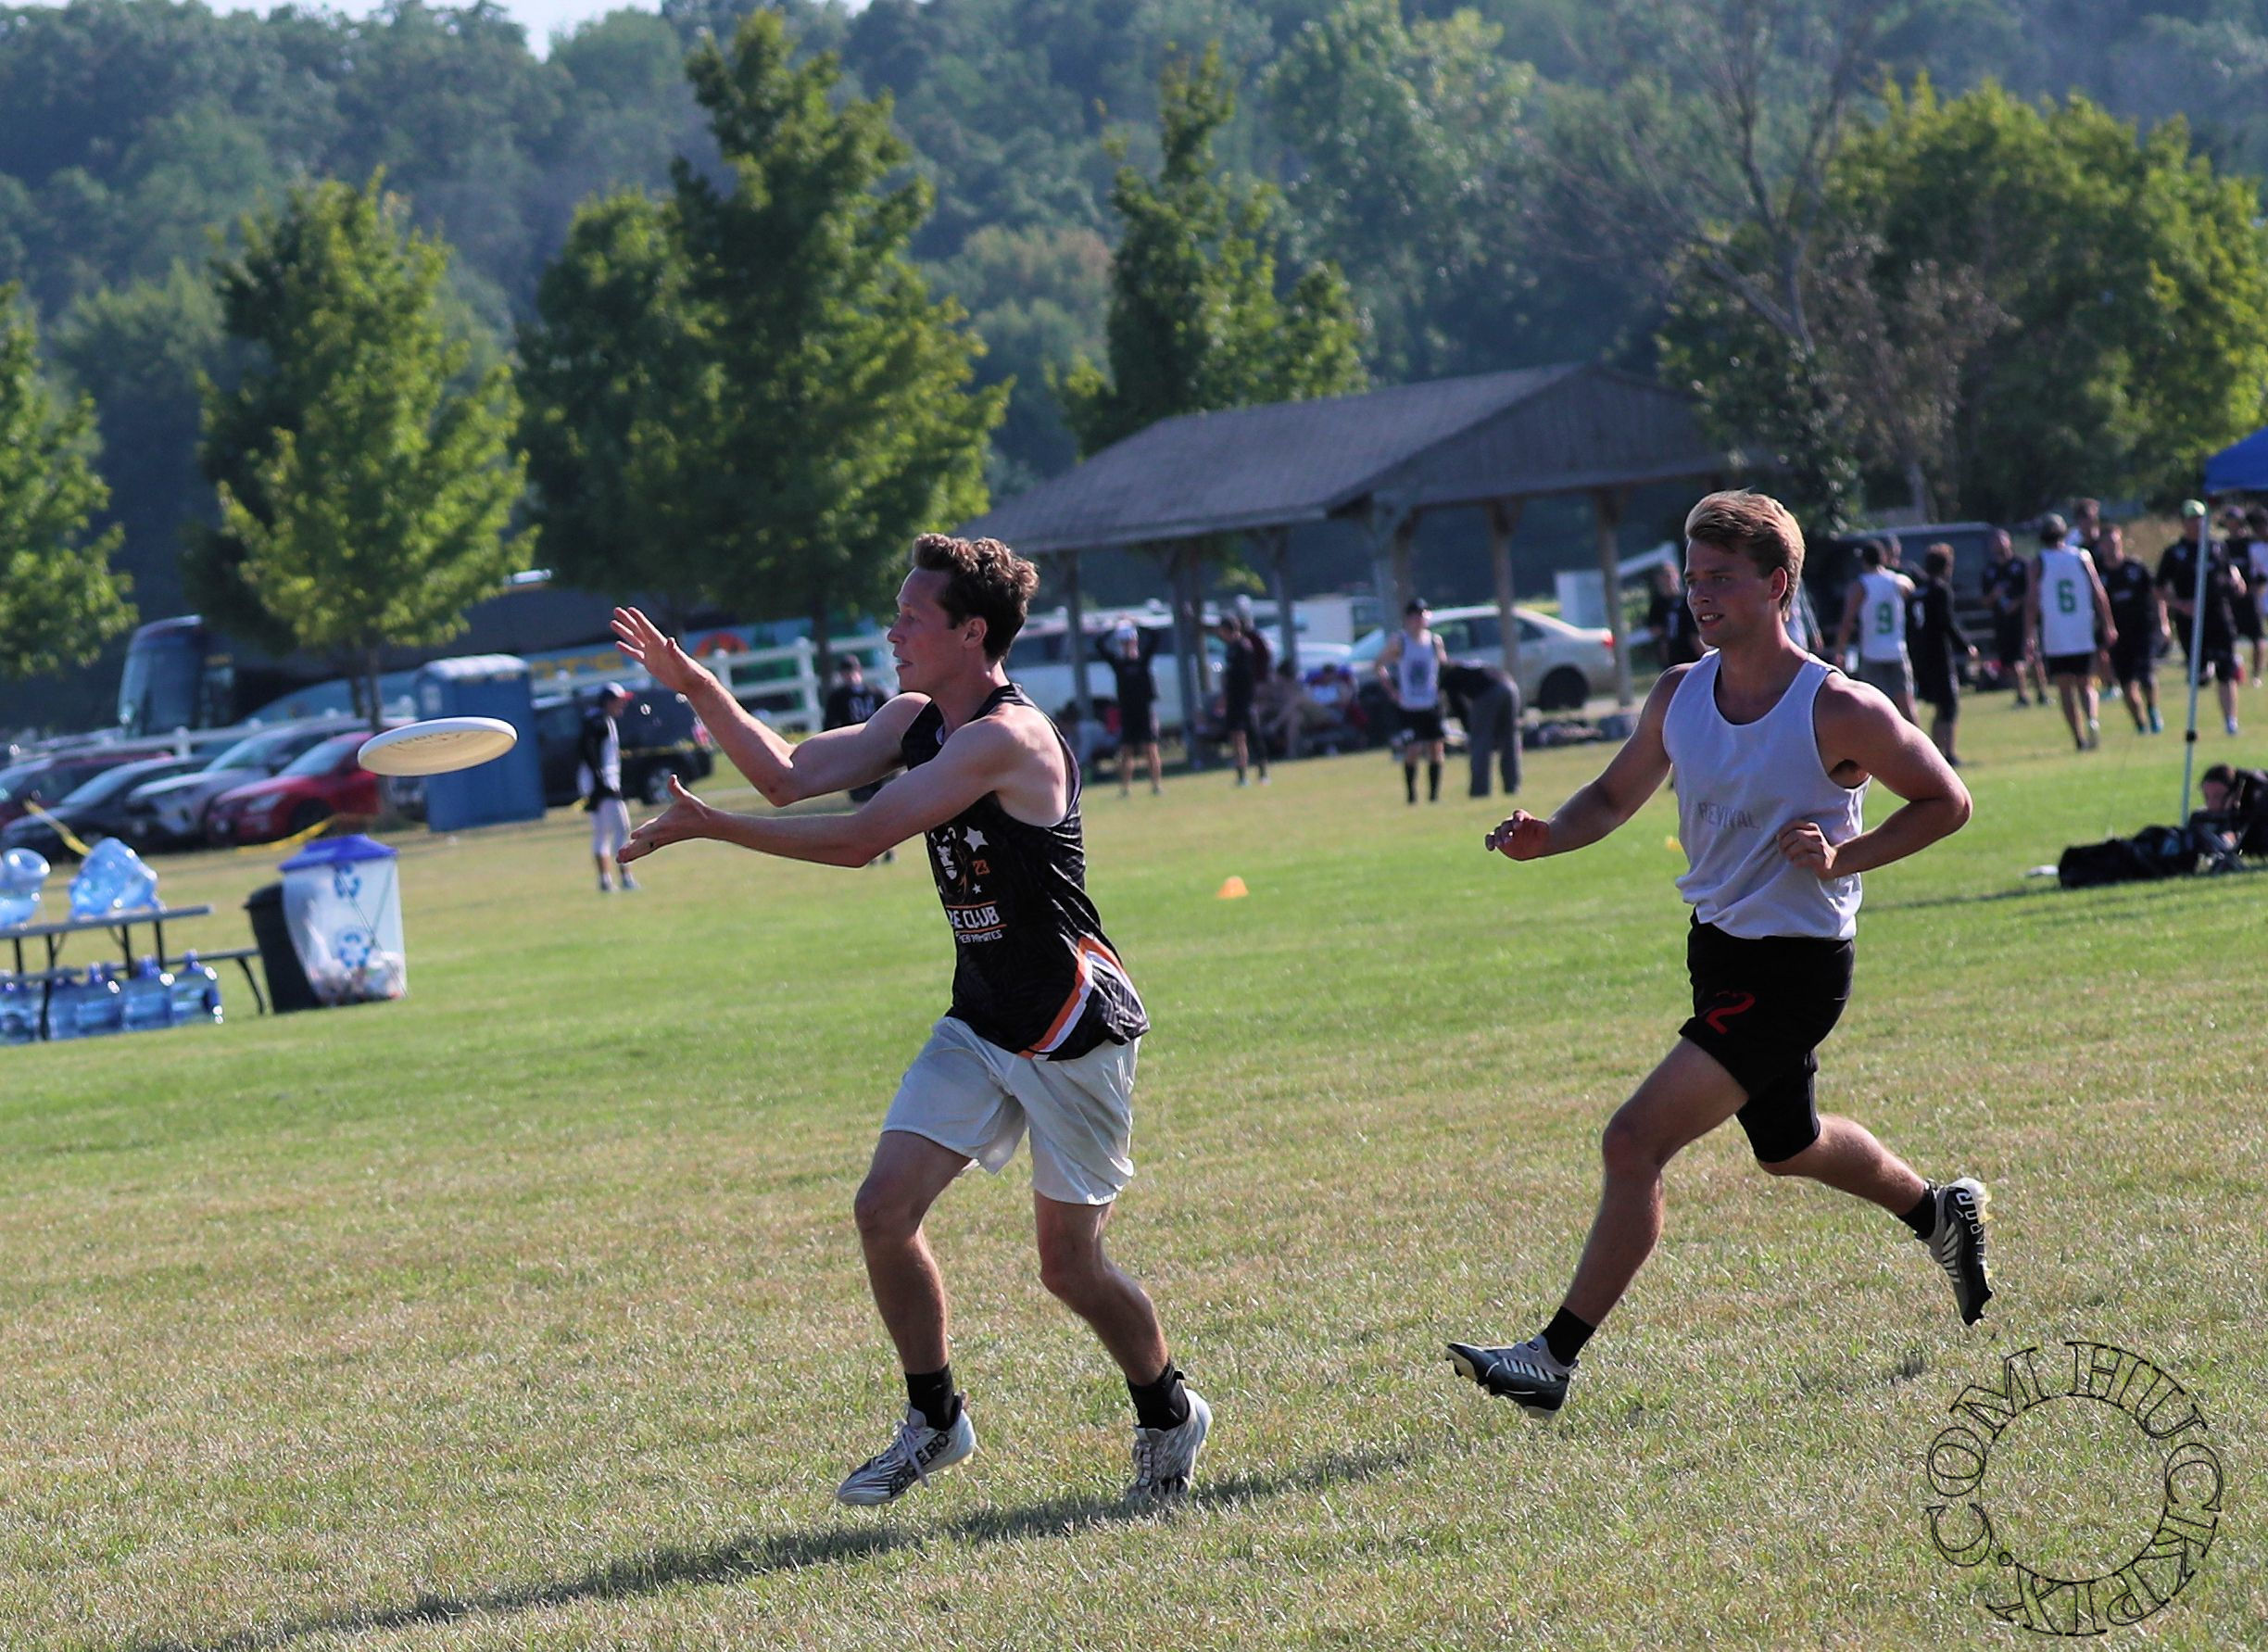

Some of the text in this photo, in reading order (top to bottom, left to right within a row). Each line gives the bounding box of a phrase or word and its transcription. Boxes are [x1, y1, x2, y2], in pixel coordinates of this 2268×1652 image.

[2056, 578, 2076, 613] 6
[1876, 601, 1893, 635] 9
[1697, 801, 1760, 831] REVIVAL
[963, 906, 1001, 929] CLUB
[1706, 990, 1756, 1035] 2
